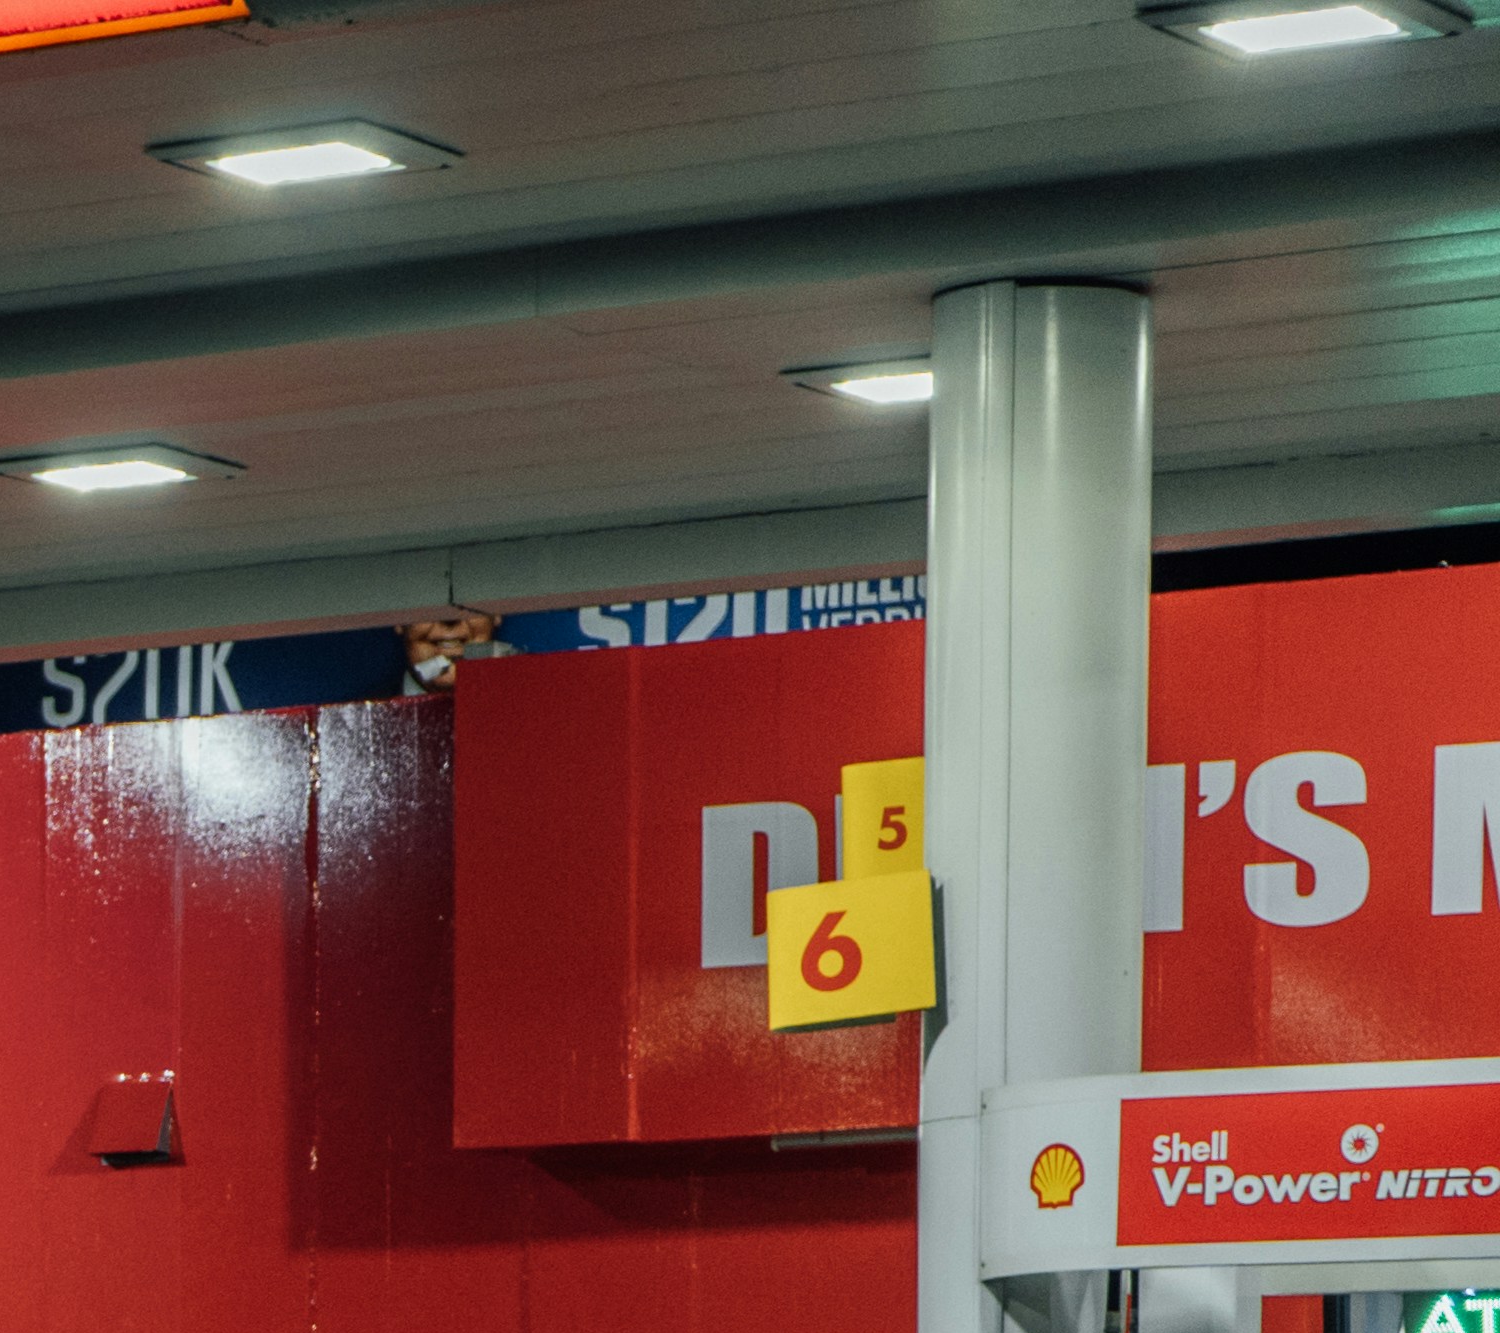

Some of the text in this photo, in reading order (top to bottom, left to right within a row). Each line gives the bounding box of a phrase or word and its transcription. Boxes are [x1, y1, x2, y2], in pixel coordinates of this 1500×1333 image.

[878, 805, 909, 851] 5
[799, 910, 864, 992] 6
[1152, 1129, 1229, 1165] Shell
[1152, 1165, 1362, 1207] V-Power
